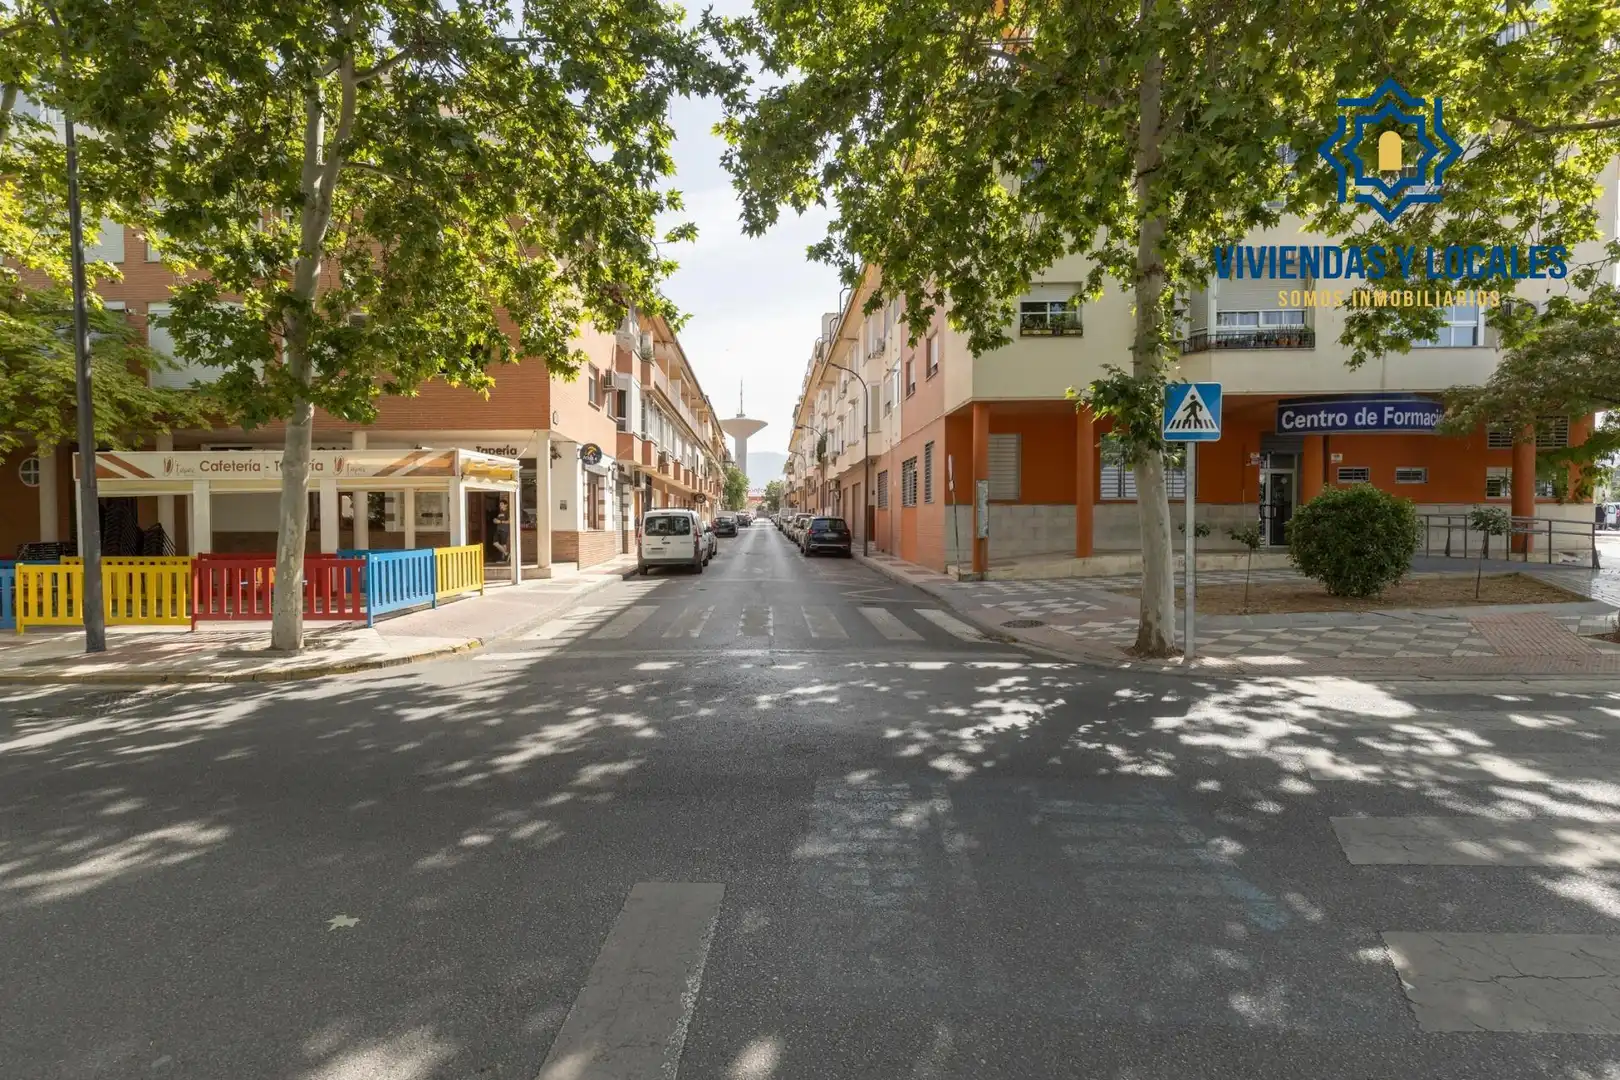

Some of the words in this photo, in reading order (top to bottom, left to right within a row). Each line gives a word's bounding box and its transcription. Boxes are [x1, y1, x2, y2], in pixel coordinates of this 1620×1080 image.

[1281, 409, 1348, 430] Centro
[1354, 406, 1378, 426] de
[199, 458, 261, 472] Cafetería
